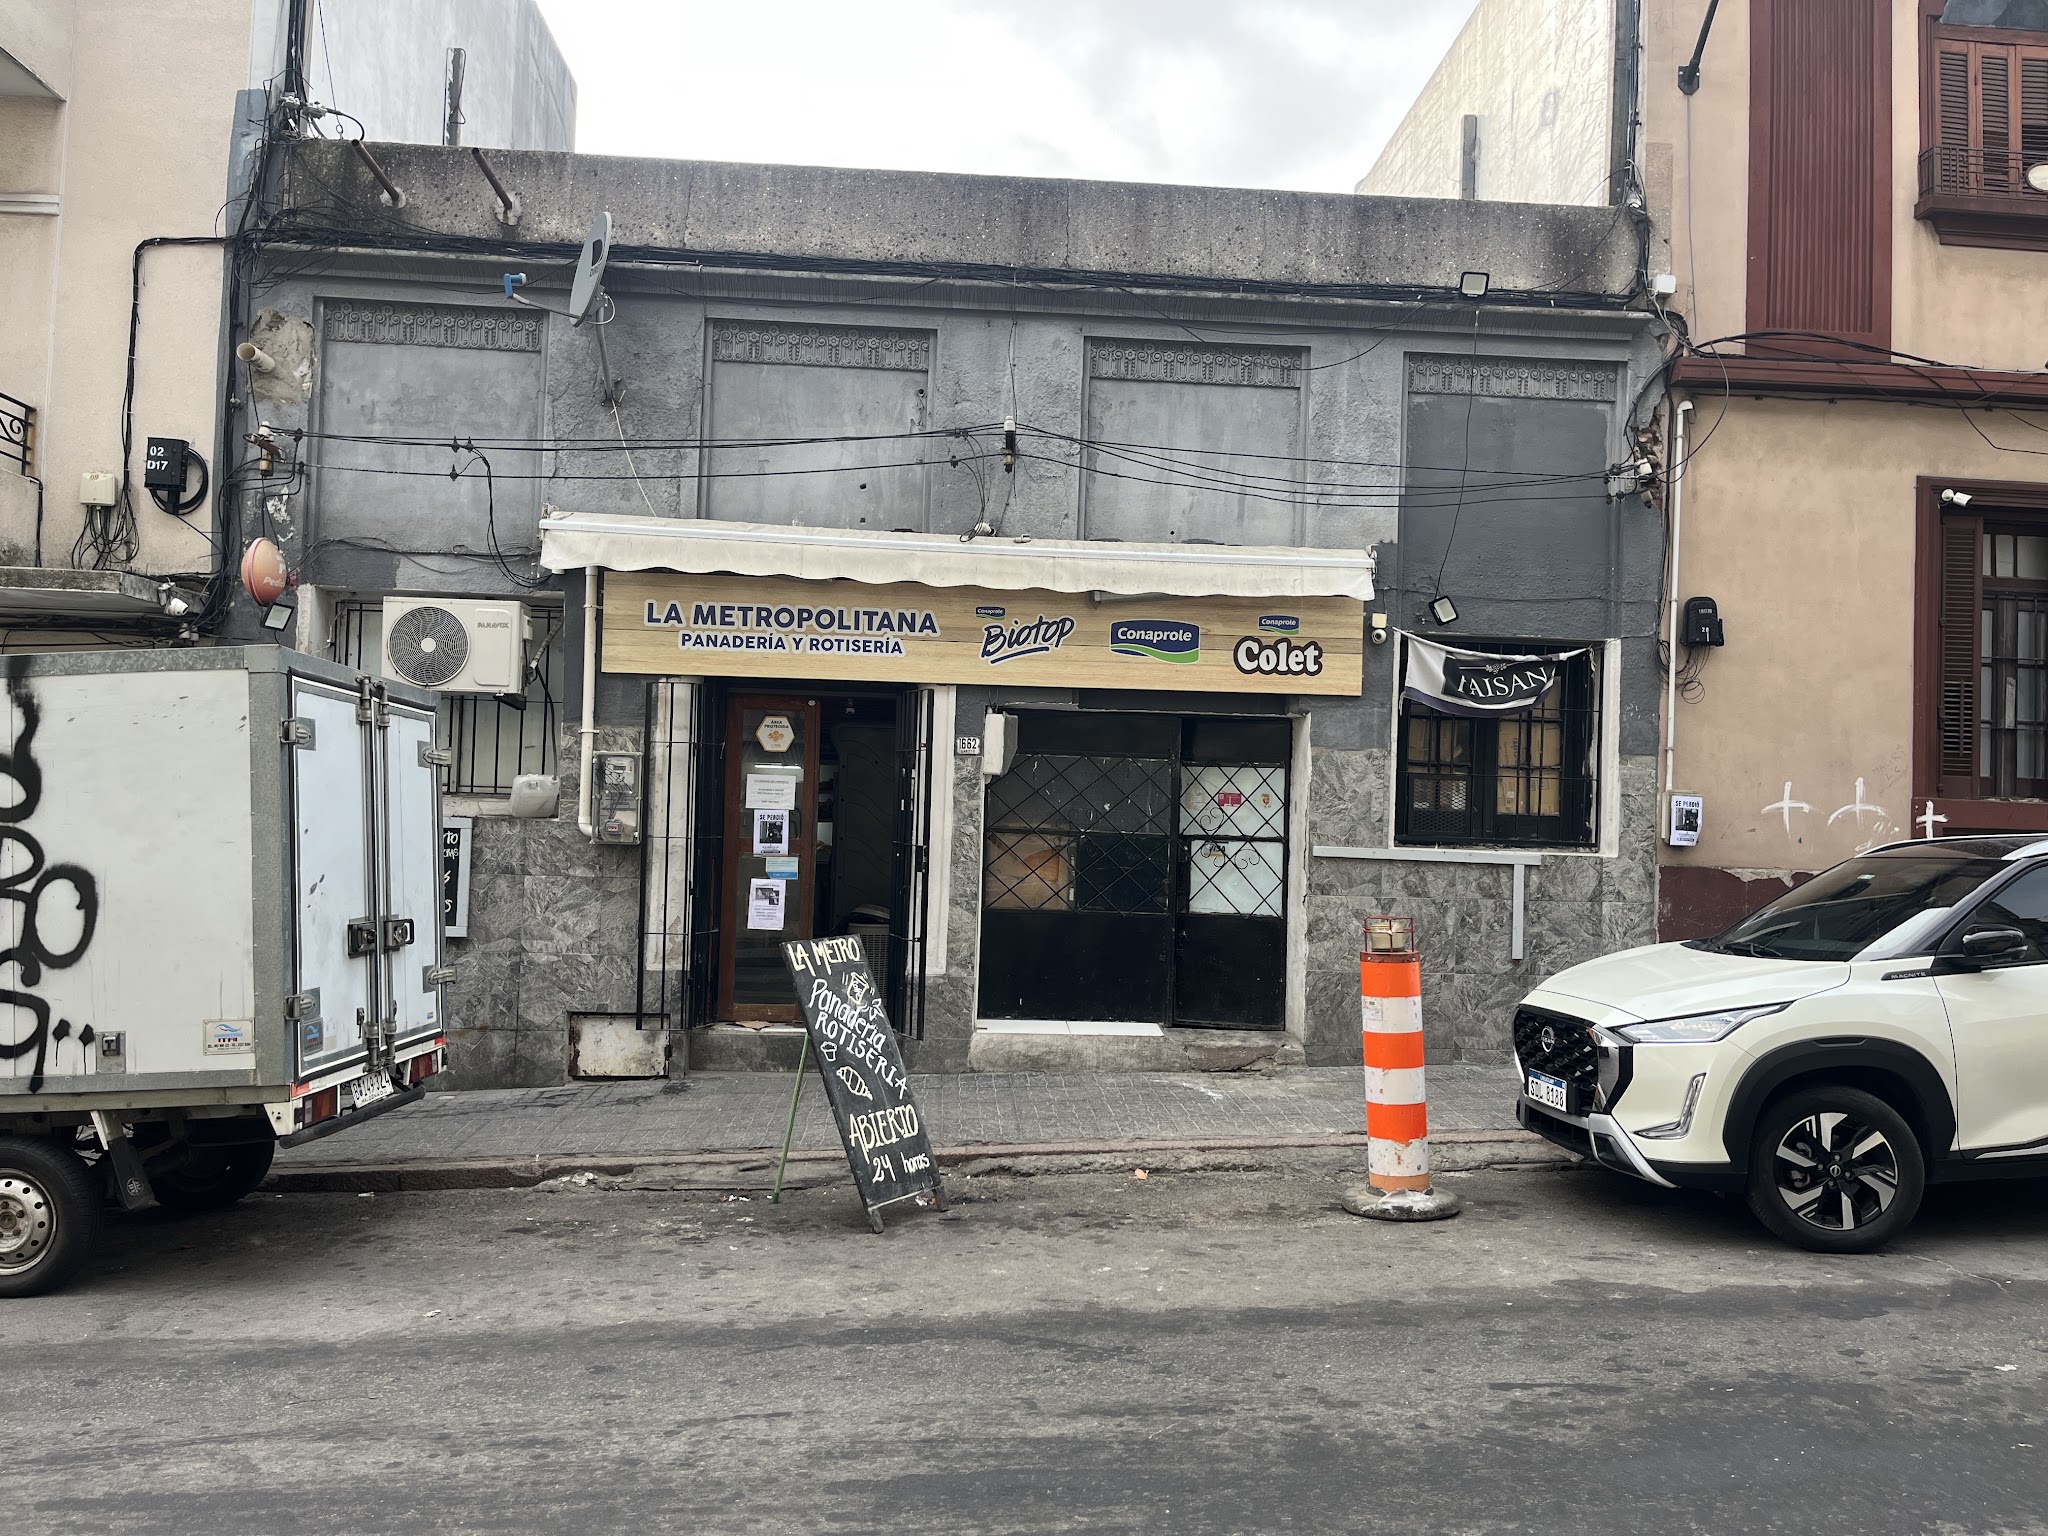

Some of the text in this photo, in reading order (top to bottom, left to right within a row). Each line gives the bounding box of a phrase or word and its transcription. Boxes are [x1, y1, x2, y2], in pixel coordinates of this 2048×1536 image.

[146, 460, 169, 471] D17
[150, 445, 165, 457] 02
[646, 602, 939, 635] LA METROPOLITANA
[1117, 626, 1193, 644] Conaprole
[1261, 618, 1297, 627] Conaprole
[680, 632, 904, 655] PANADERÍA Y ROTISERÍA
[980, 615, 1075, 658] Biotop
[1236, 638, 1319, 673] Colet
[787, 936, 861, 977] LA METRO
[1890, 971, 1927, 980] MAGNITE
[814, 1010, 908, 1100] ROTISERIA
[849, 1103, 920, 1164] ABIERTO
[871, 1151, 931, 1184] 24 horas
